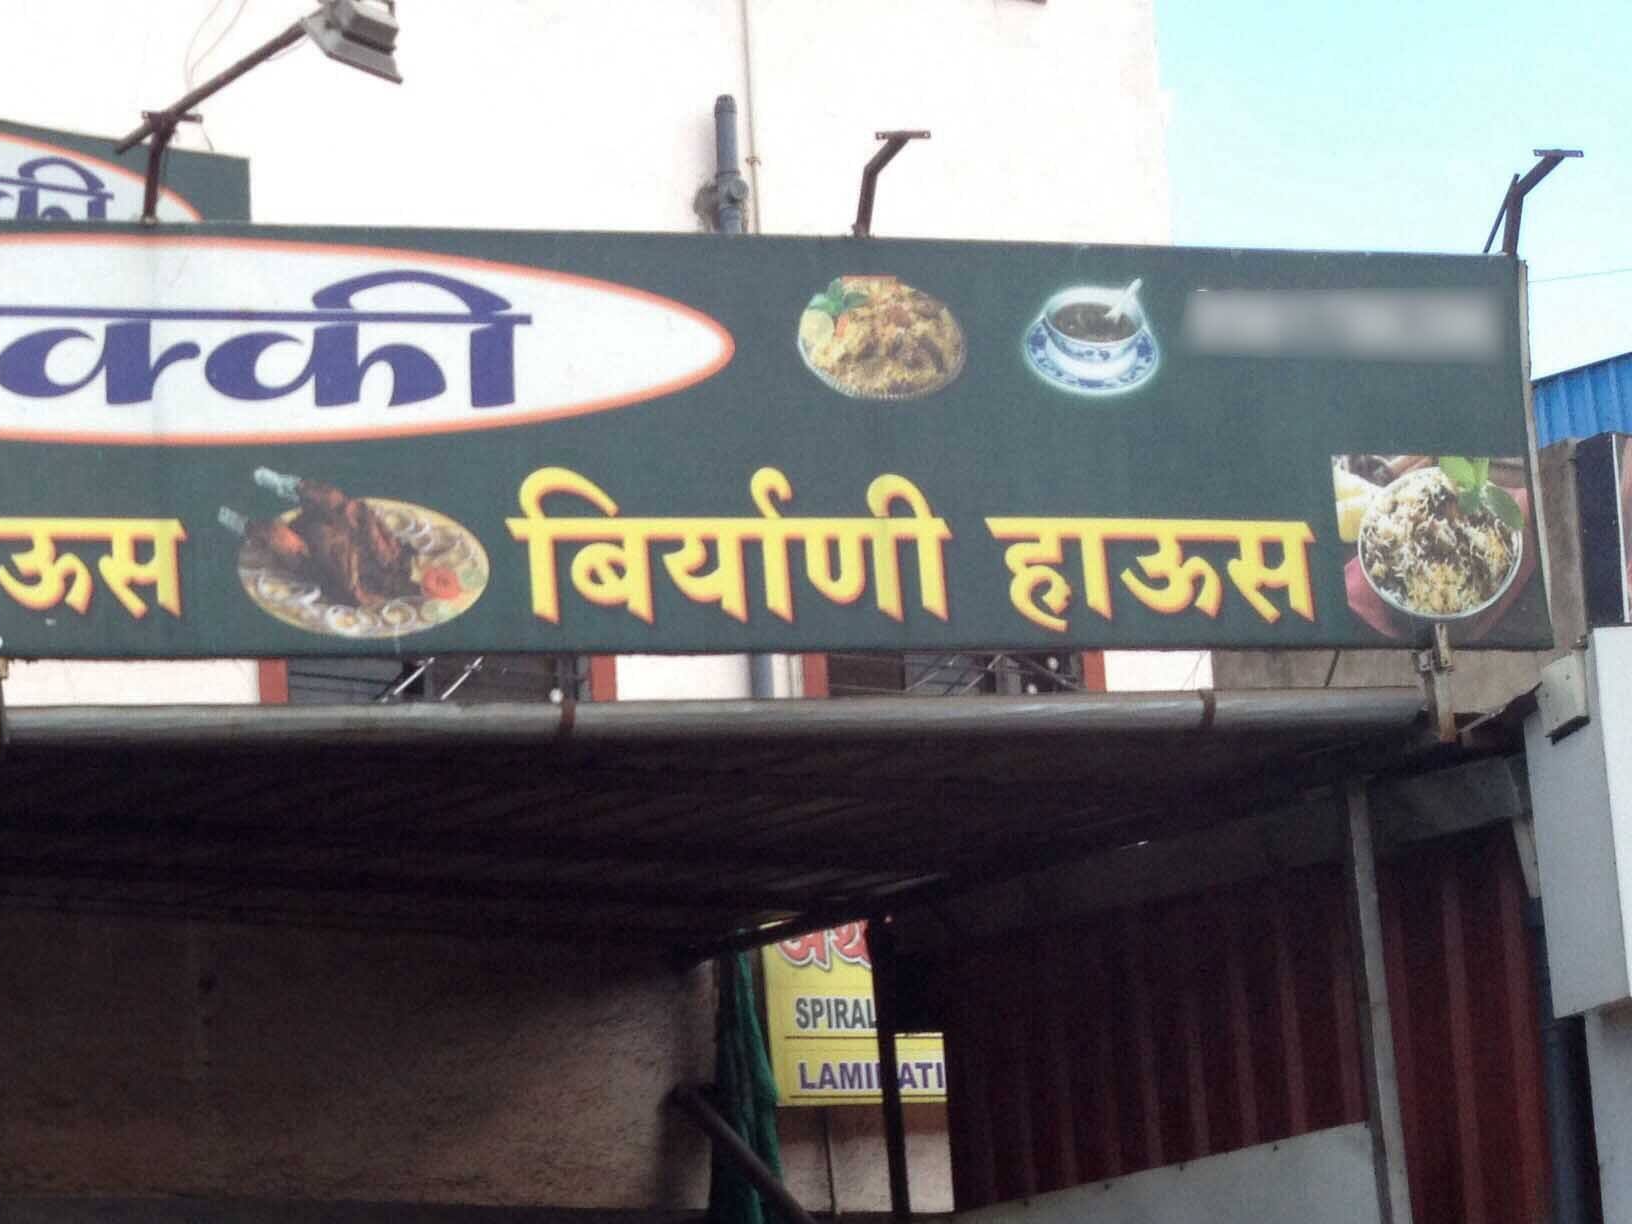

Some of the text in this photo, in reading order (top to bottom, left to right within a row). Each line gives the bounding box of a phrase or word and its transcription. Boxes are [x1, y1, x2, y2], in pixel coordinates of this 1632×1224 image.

[506, 467, 950, 623] बिर्याणी
[986, 518, 1316, 632] हाऊस
[796, 998, 876, 1029] SPIRAL
